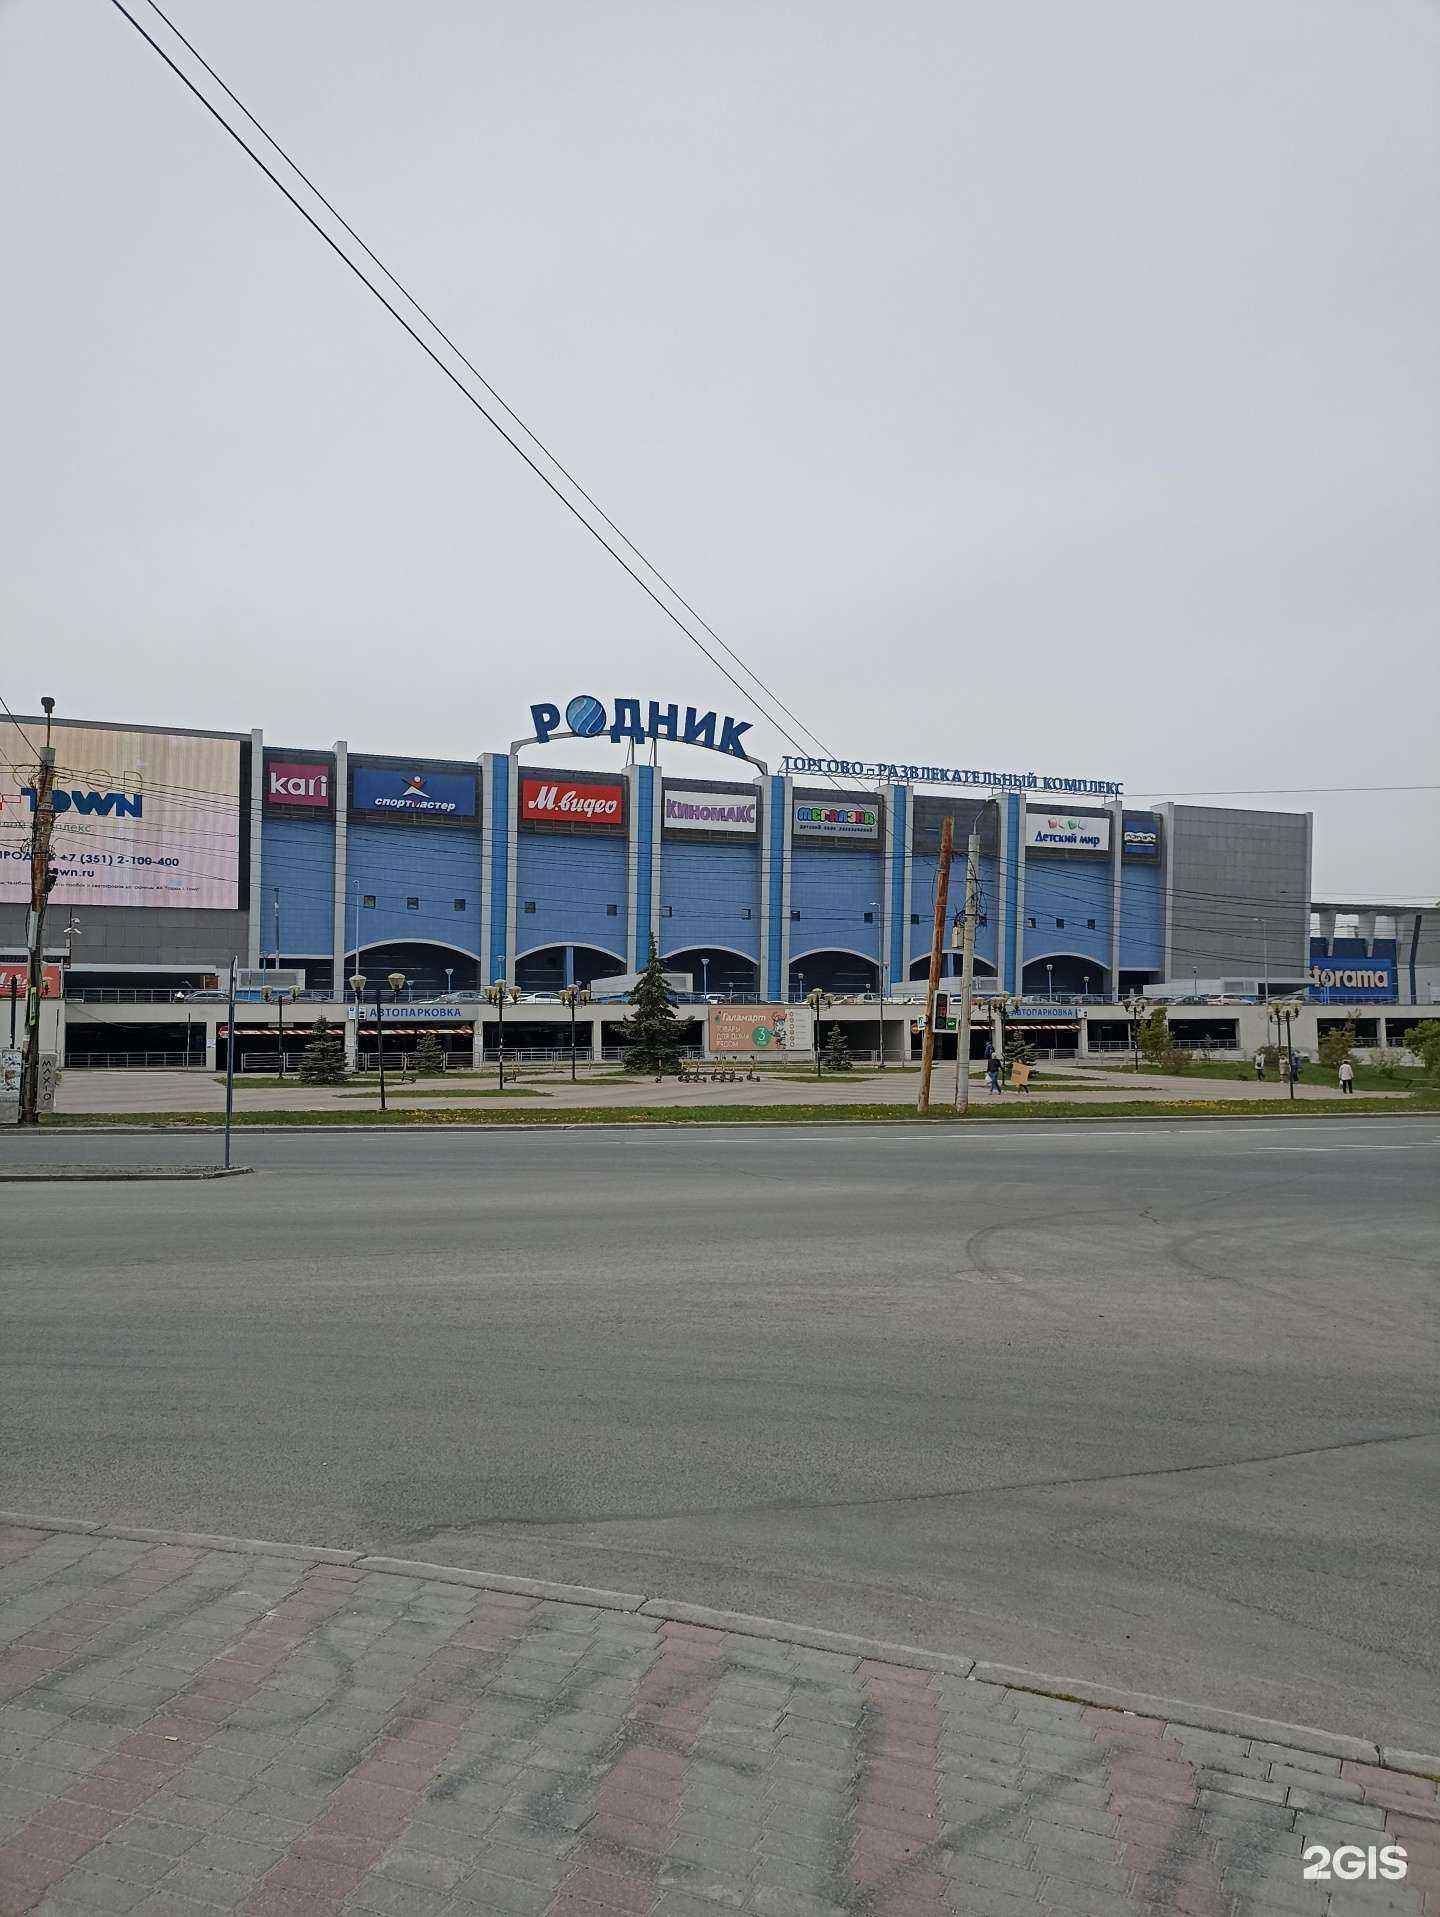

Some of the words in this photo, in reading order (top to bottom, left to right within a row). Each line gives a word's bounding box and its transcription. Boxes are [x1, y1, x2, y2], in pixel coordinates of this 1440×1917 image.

[530, 695, 753, 758] РОДНИК
[270, 771, 328, 797] kari
[1043, 776, 1125, 795] КОМПЛЕКС
[20, 788, 143, 818] TOWN
[528, 786, 617, 817] М.видео
[666, 799, 755, 823] КИНОМАКС
[1035, 831, 1077, 844] Детский
[1080, 836, 1100, 847] мир
[60, 854, 76, 862] +7
[80, 853, 113, 866] (351)
[1309, 965, 1388, 988] torama
[369, 1007, 462, 1018] АВТОПАРКОВКА
